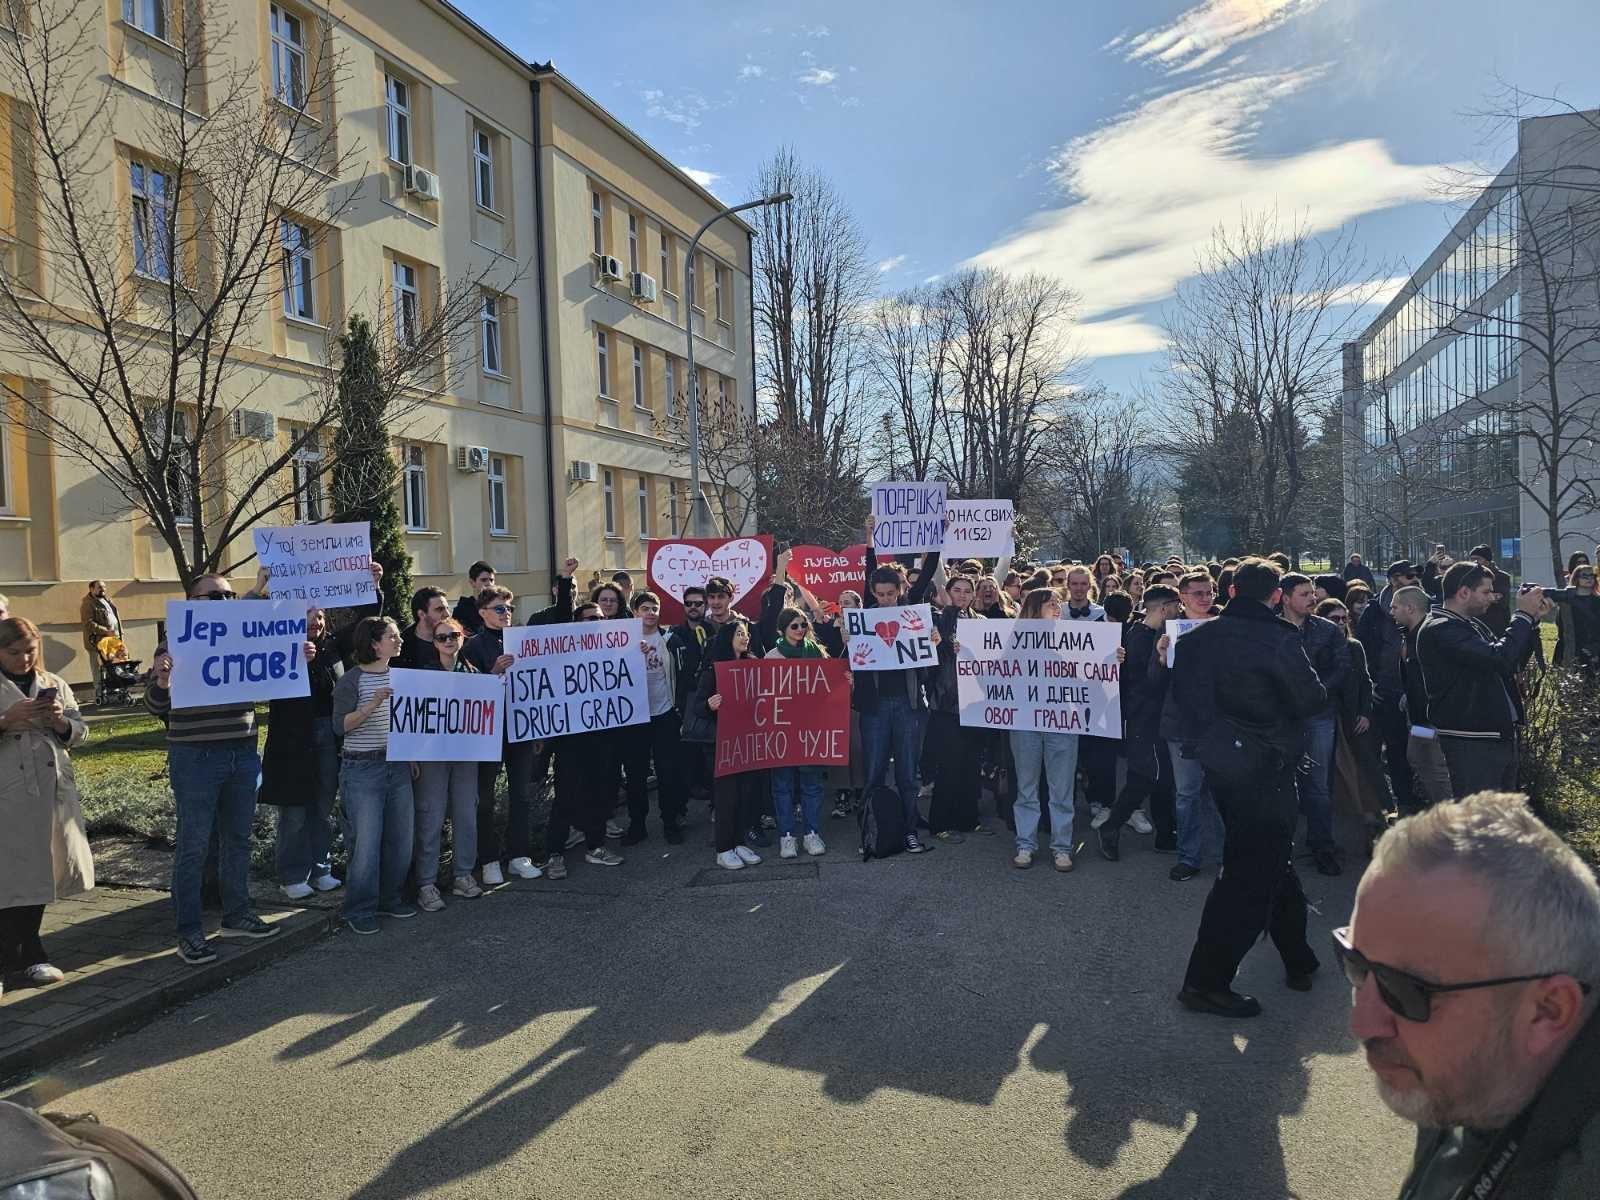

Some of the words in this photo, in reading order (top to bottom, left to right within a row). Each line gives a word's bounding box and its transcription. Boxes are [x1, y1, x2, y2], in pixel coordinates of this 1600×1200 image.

[876, 488, 944, 516] ПОДРШКА
[261, 531, 274, 555] У
[873, 519, 945, 549] КОЛЕГАМА!
[953, 527, 992, 541] 11(52)
[668, 556, 751, 572] СТУДЕНТИ
[803, 556, 849, 568] ЉУБАВ
[805, 572, 822, 585] НА
[177, 609, 228, 647] Јер
[242, 618, 307, 638] имам
[848, 612, 876, 636] BL
[606, 631, 629, 649] SAD
[896, 637, 932, 664] NS
[984, 631, 1002, 650] НА
[1012, 631, 1094, 651] УЛИЦАМА
[509, 667, 555, 704] ISTA
[564, 657, 634, 696] BORBA
[728, 665, 831, 702] ТИШИНА
[958, 660, 1022, 678] БЕОГРАДА
[1028, 660, 1038, 678] И
[1045, 661, 1078, 678] НОВОГ
[1084, 662, 1119, 682] САДА
[987, 684, 1014, 701] ИМА
[1028, 685, 1038, 702] И
[1046, 686, 1090, 705] ДЈЕЦЕ
[389, 695, 495, 736] КАМЕНОЛОМ
[513, 701, 570, 740] DRUGI
[580, 695, 634, 729] GRAD
[754, 696, 792, 727] СЕ
[985, 706, 1018, 725] ОВОГ
[1034, 707, 1091, 732] ГРАДА!
[719, 731, 788, 770] ДАЛЕКО
[799, 729, 845, 760] ЧУЈЕ
